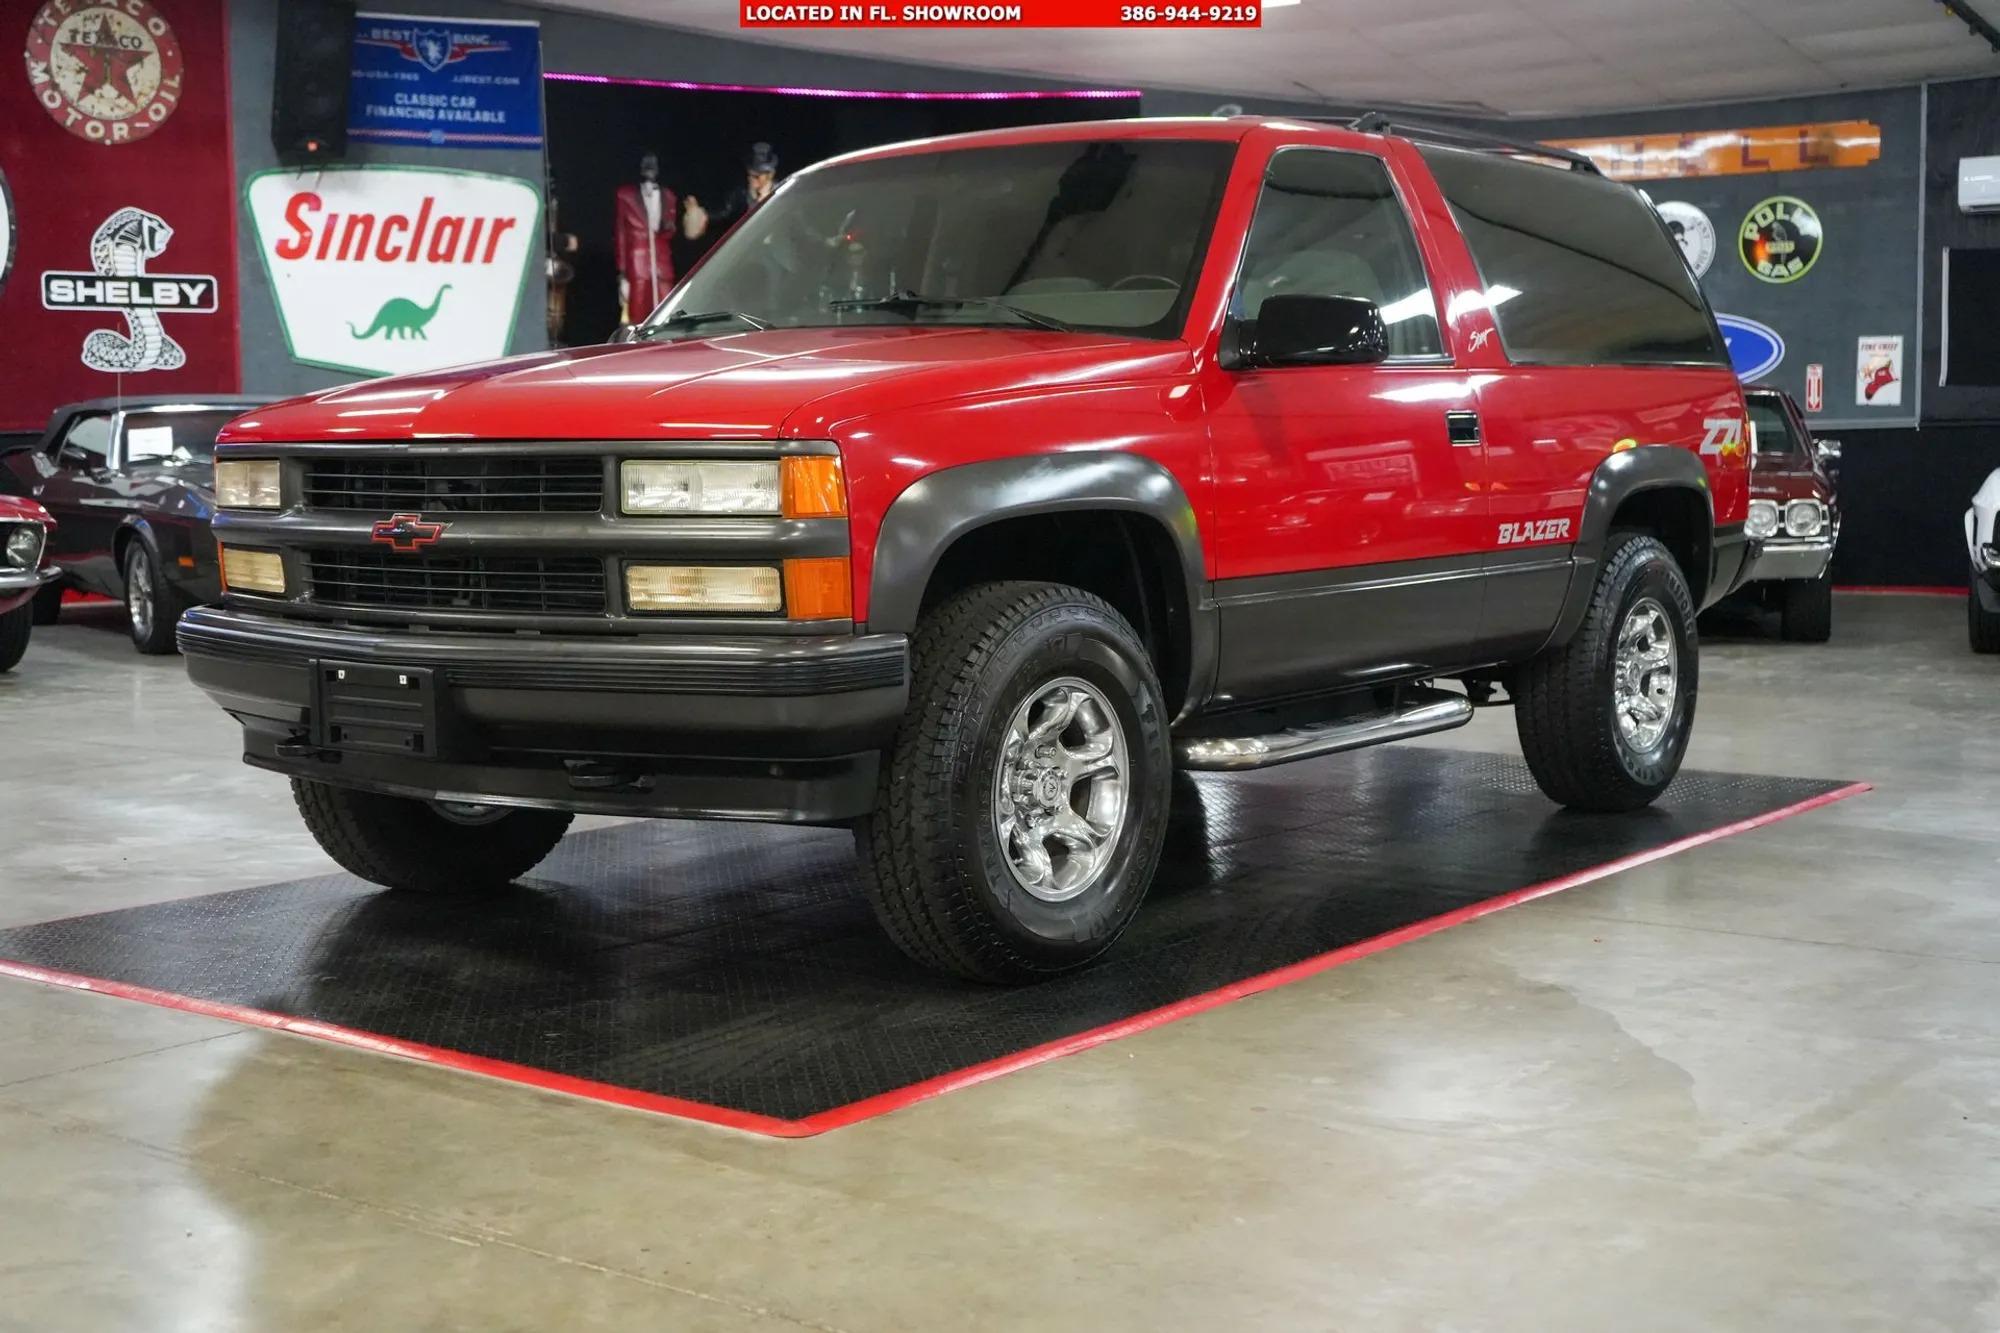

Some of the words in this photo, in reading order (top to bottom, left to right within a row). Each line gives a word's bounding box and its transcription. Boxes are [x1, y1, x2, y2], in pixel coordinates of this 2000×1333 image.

[39, 0, 166, 36] TECO
[394, 92, 448, 107] CLASSIC
[449, 95, 477, 108] CAR
[365, 104, 436, 120] FINANCING
[437, 108, 506, 123] AVAILABLE
[275, 191, 518, 264] Sinclair
[1743, 202, 1820, 240] POLL
[1757, 255, 1804, 278] GAS
[49, 280, 208, 306] SHELBY
[1497, 518, 1570, 545] BLAZER
